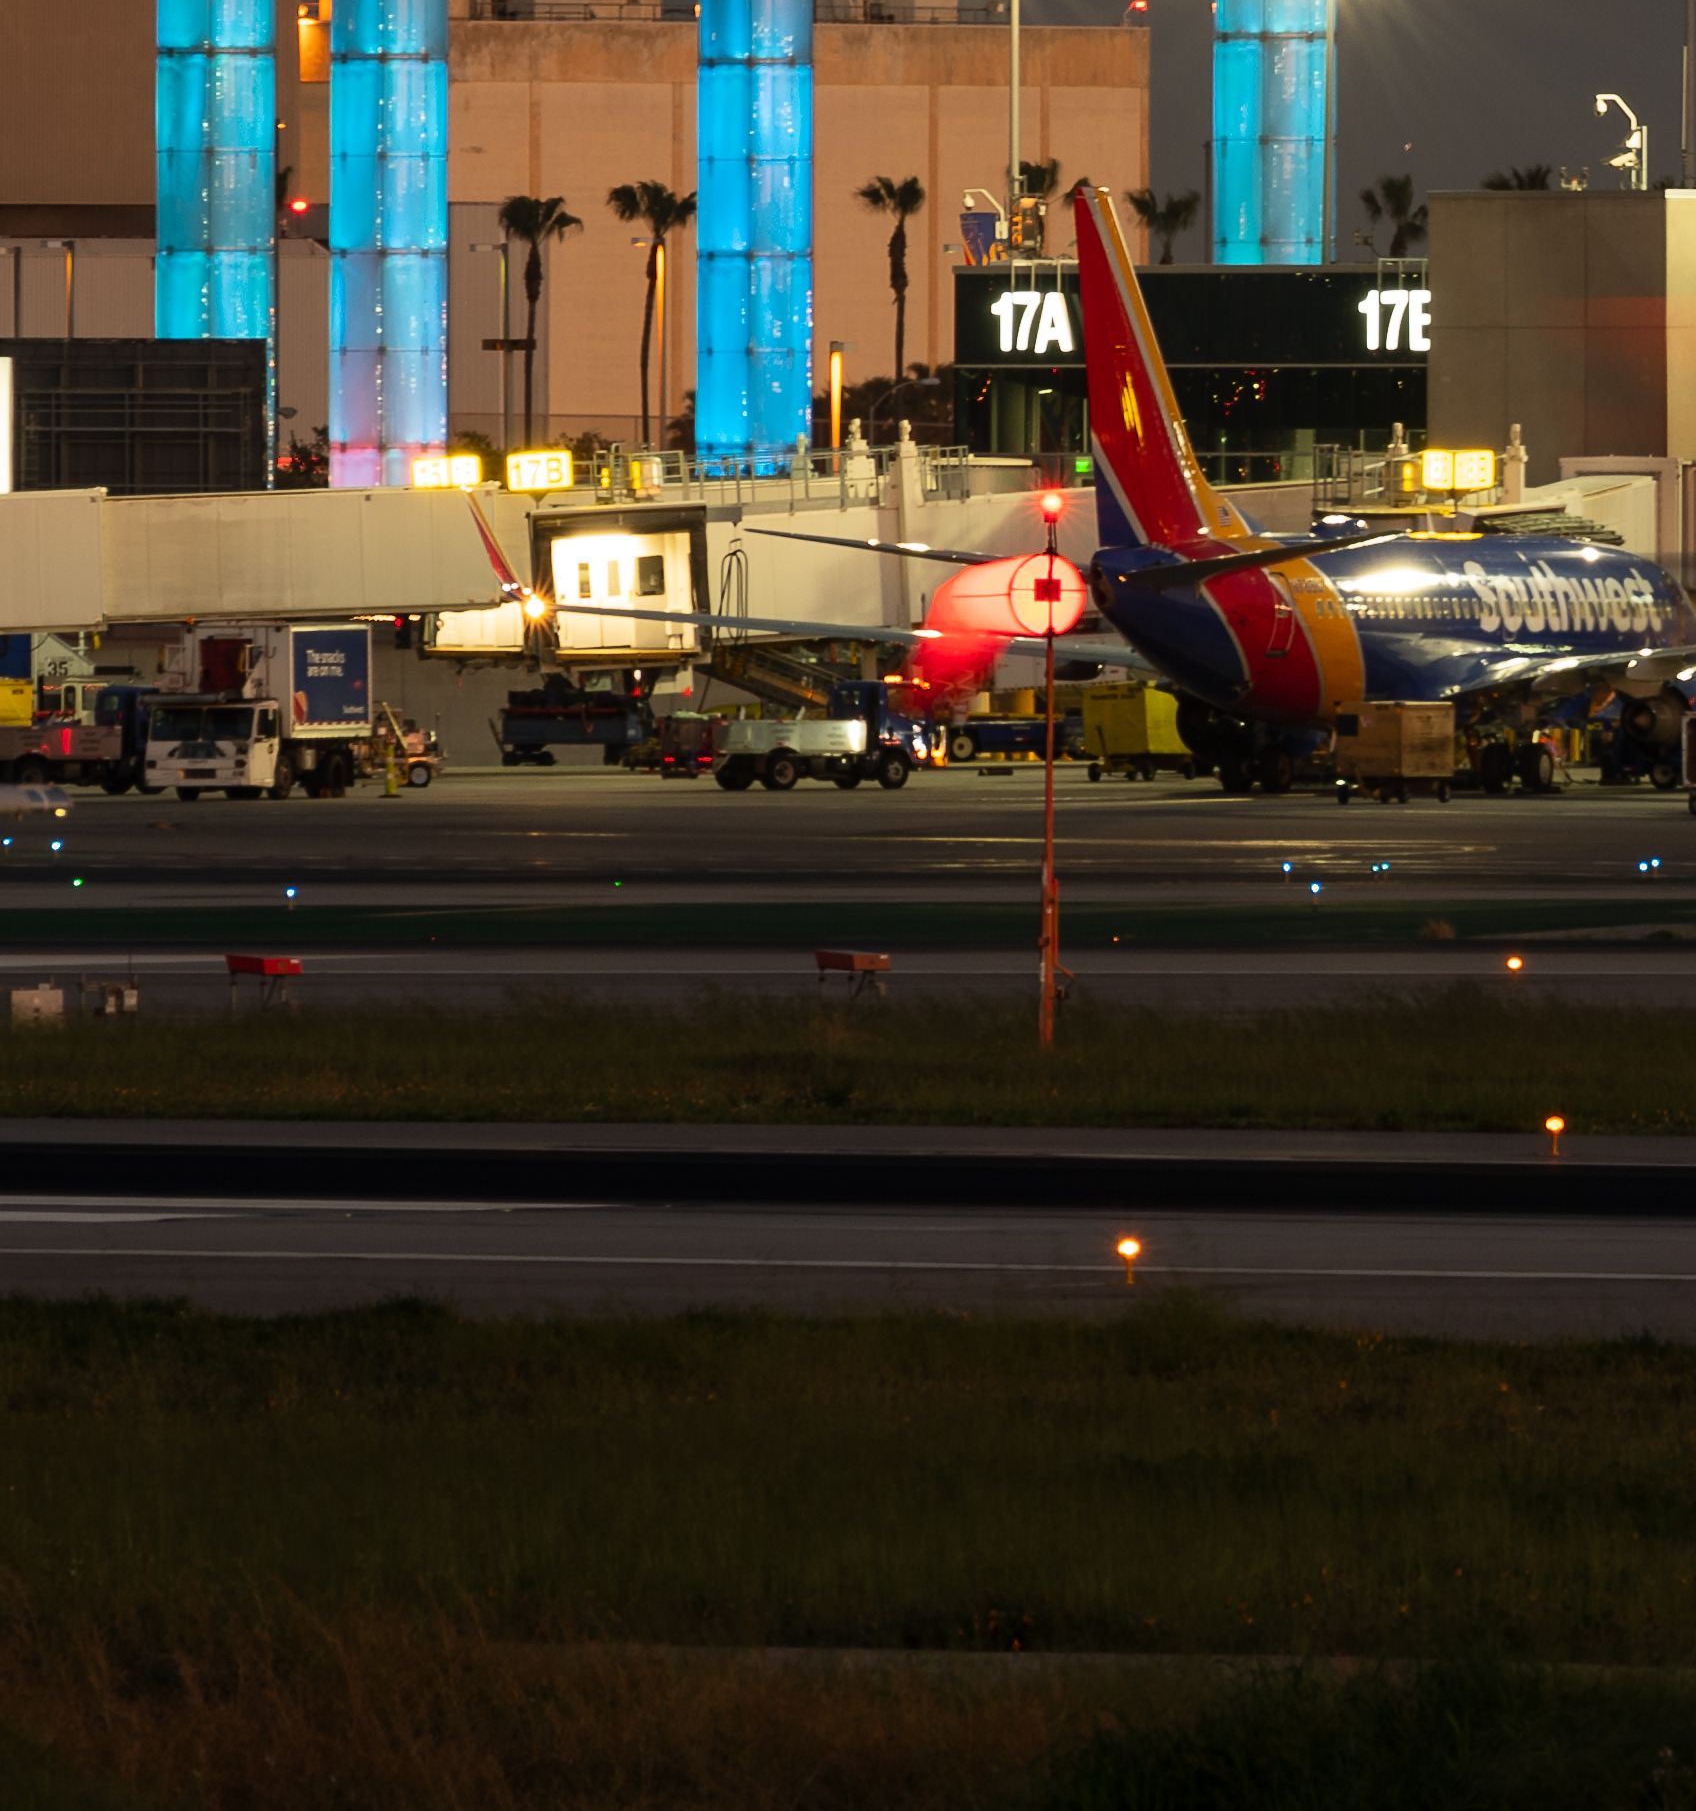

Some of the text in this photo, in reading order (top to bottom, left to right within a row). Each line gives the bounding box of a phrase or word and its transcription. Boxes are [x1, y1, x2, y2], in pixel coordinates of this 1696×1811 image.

[991, 290, 1073, 353] 17A
[511, 458, 563, 488] 17B
[1463, 560, 1663, 633] Southwest
[48, 661, 68, 677] 35
